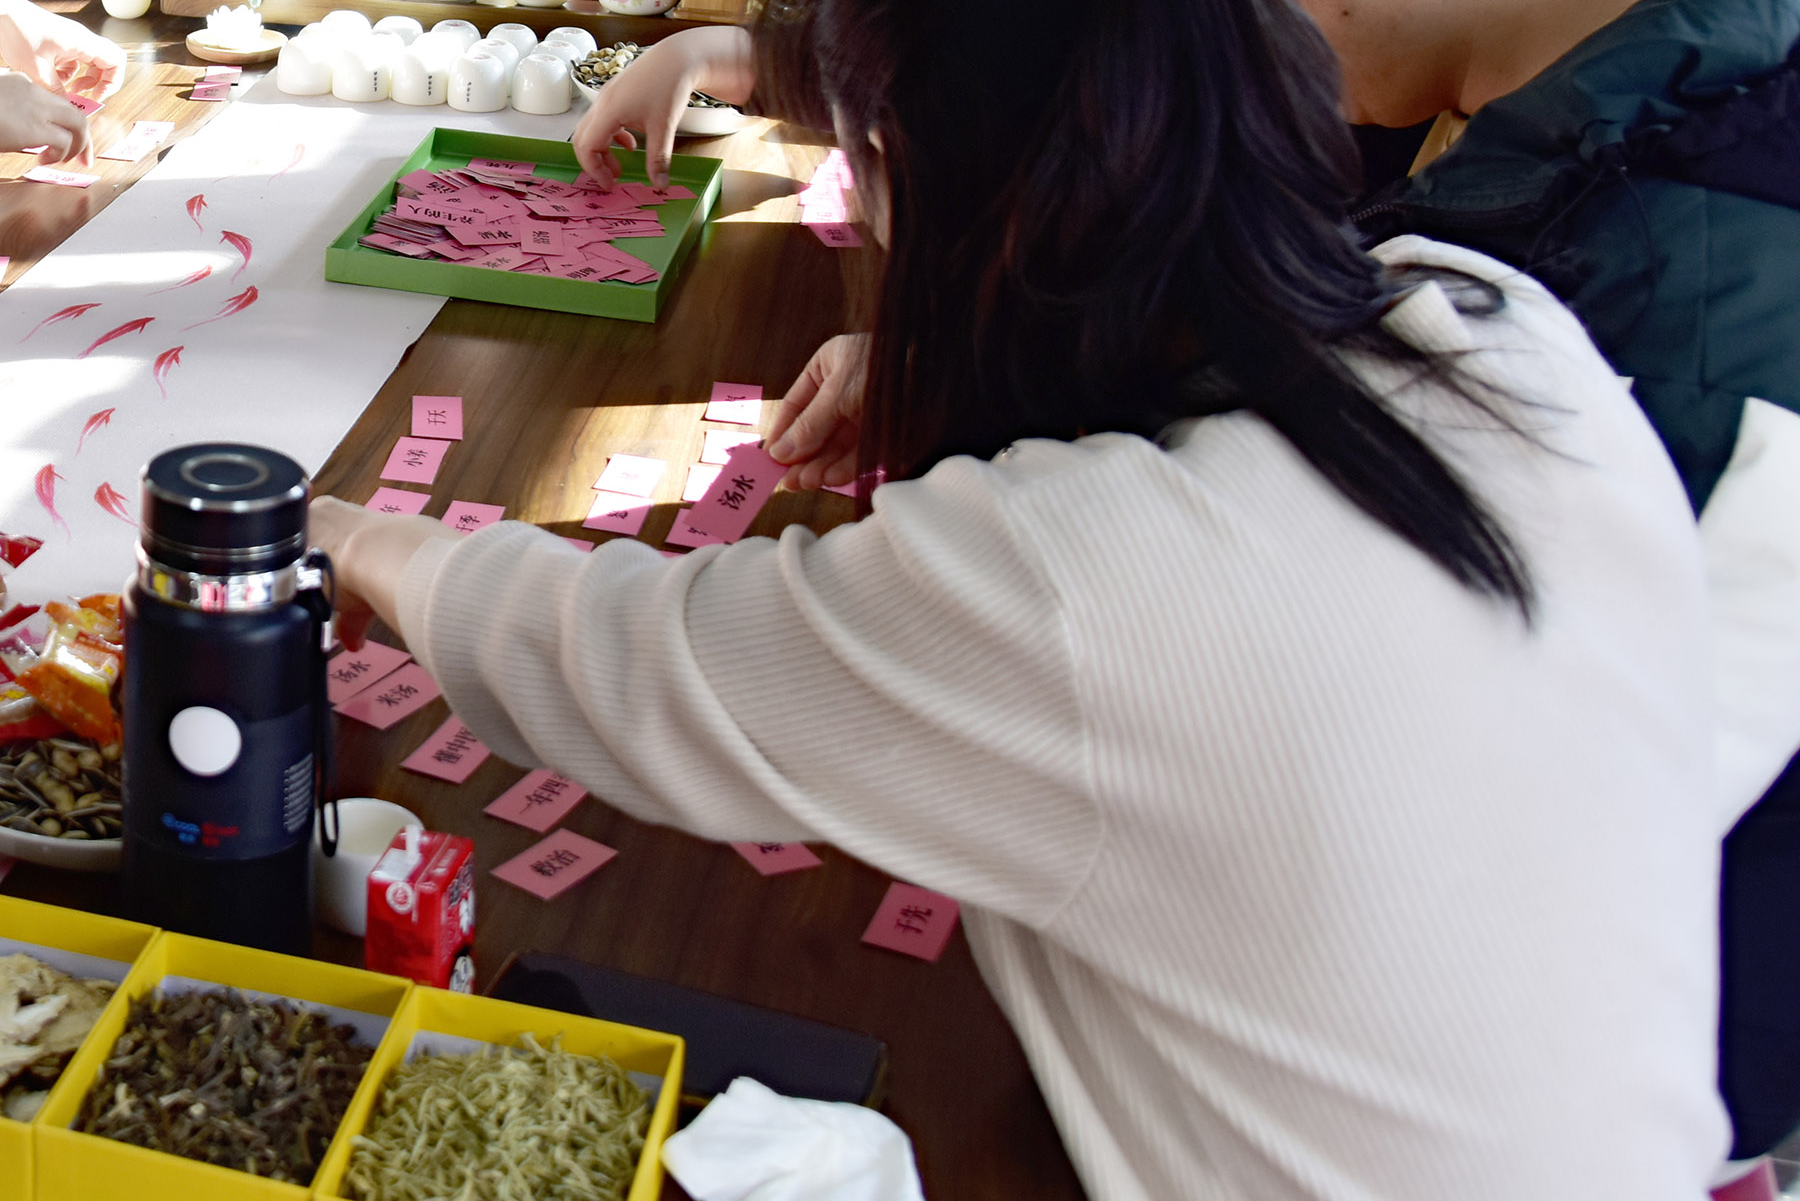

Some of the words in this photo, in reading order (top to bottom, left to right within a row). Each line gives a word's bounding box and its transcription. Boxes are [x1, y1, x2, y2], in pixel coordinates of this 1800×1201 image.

[407, 204, 475, 225] 养生的人
[403, 449, 428, 467] 小养
[716, 474, 756, 511] 汤水
[329, 659, 371, 683] 汤水
[376, 683, 419, 708] 米汤
[529, 849, 581, 878] 救治
